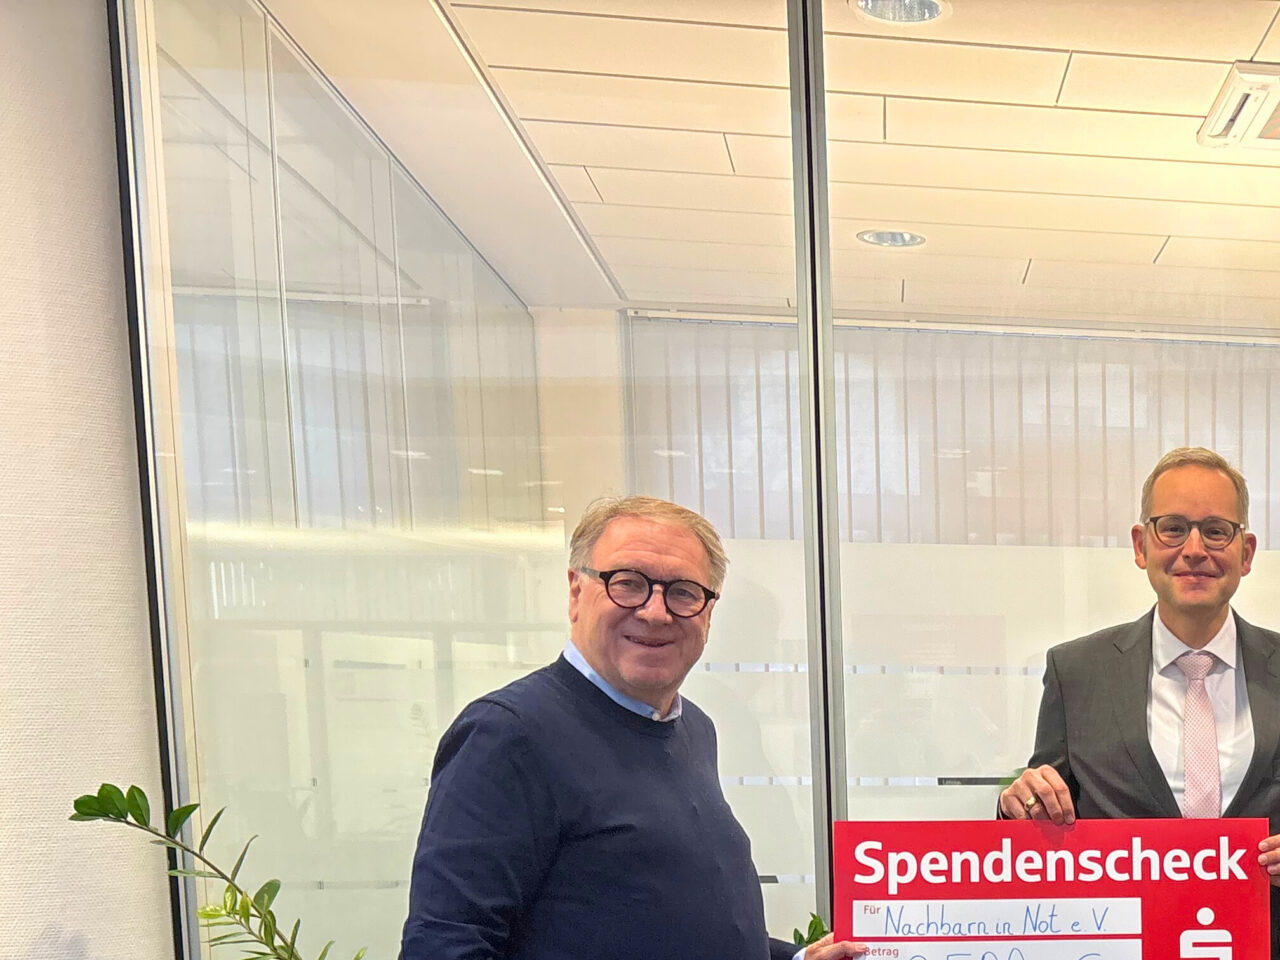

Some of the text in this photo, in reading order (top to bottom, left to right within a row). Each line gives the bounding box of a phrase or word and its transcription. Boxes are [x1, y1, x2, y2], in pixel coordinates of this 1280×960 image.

[853, 836, 1249, 895] Spendenscheck
[863, 904, 881, 915] Für
[884, 903, 989, 936] Nachbarn
[995, 918, 1014, 935] in
[1022, 903, 1061, 935] Not
